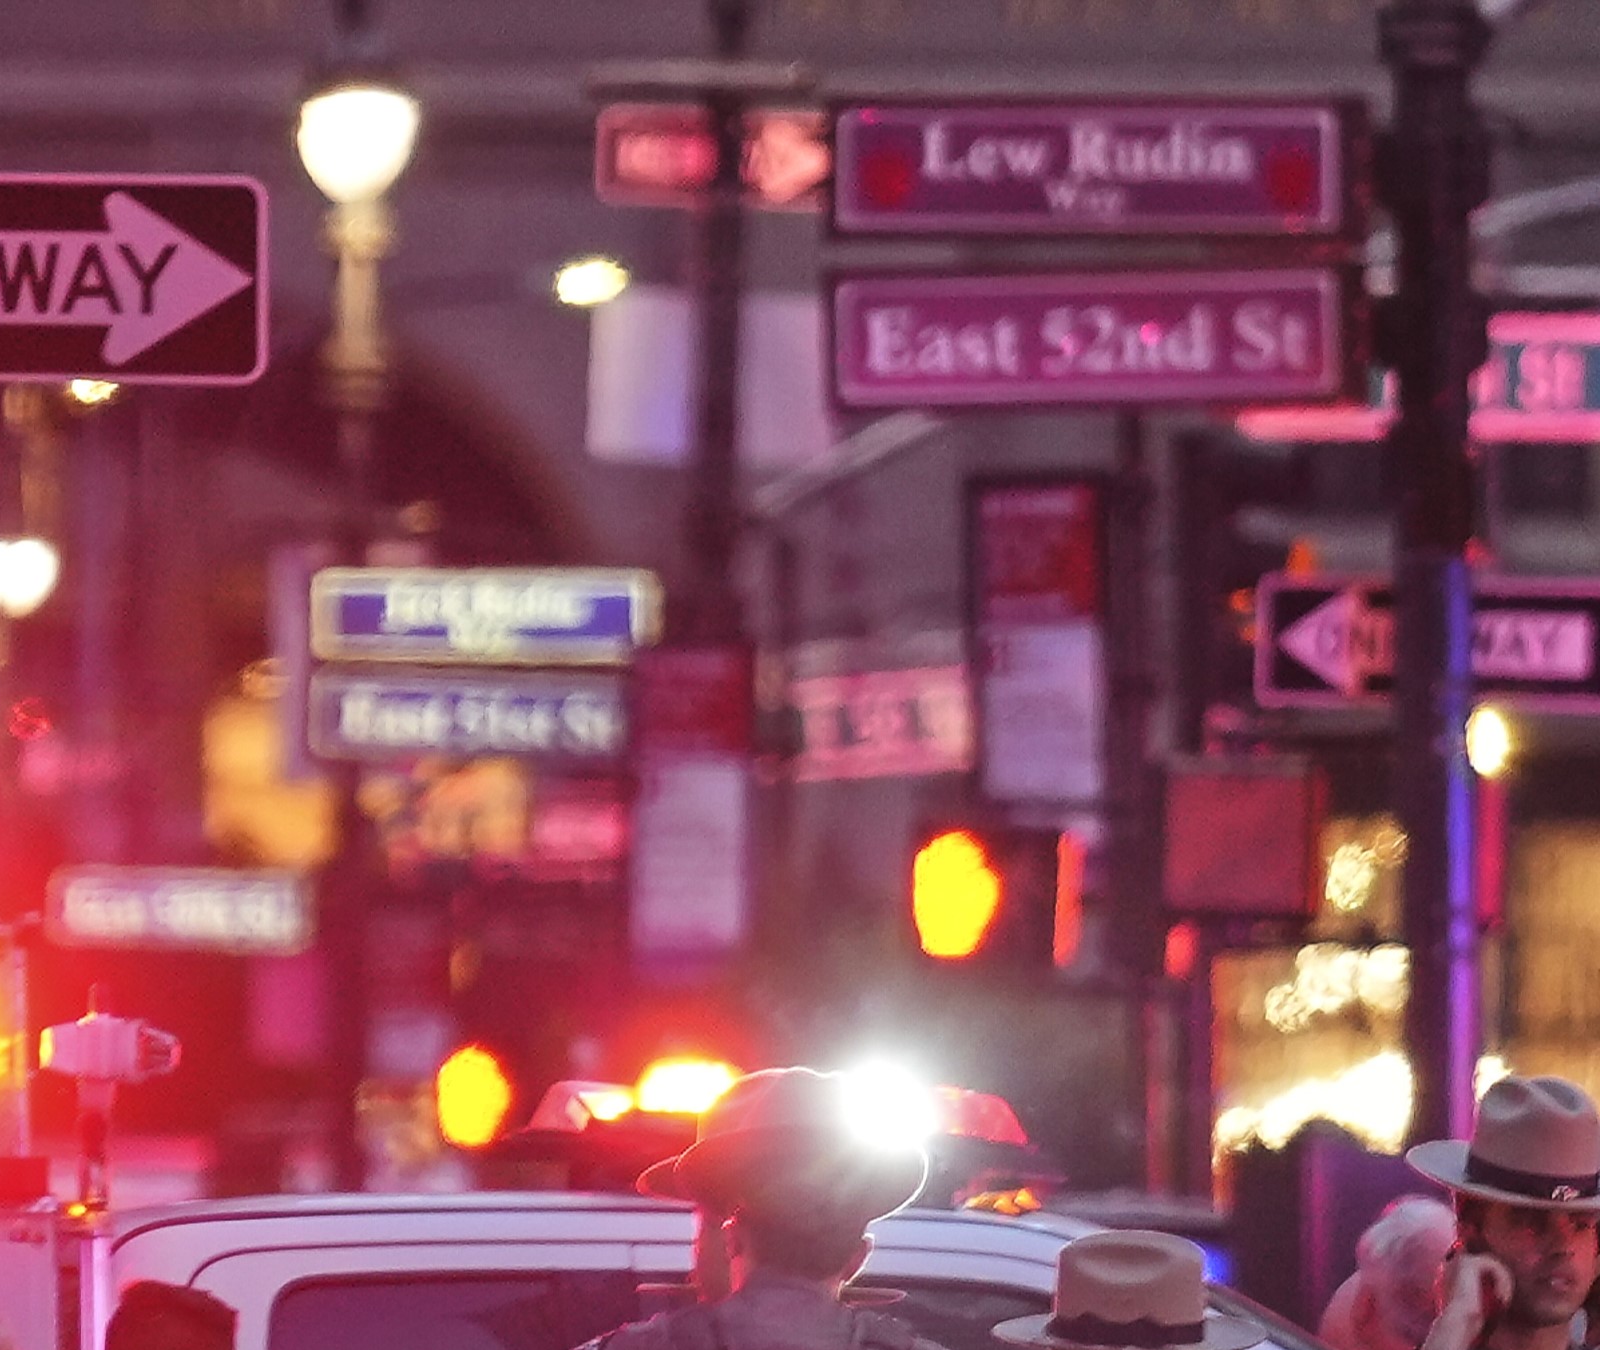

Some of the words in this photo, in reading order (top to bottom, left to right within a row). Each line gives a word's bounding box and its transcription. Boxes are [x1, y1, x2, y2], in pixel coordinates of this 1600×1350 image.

[921, 119, 1049, 180] Lew
[1069, 117, 1255, 183] Rudin
[864, 305, 1019, 377] East
[1040, 305, 1215, 373] 52nd
[1231, 302, 1312, 374] St
